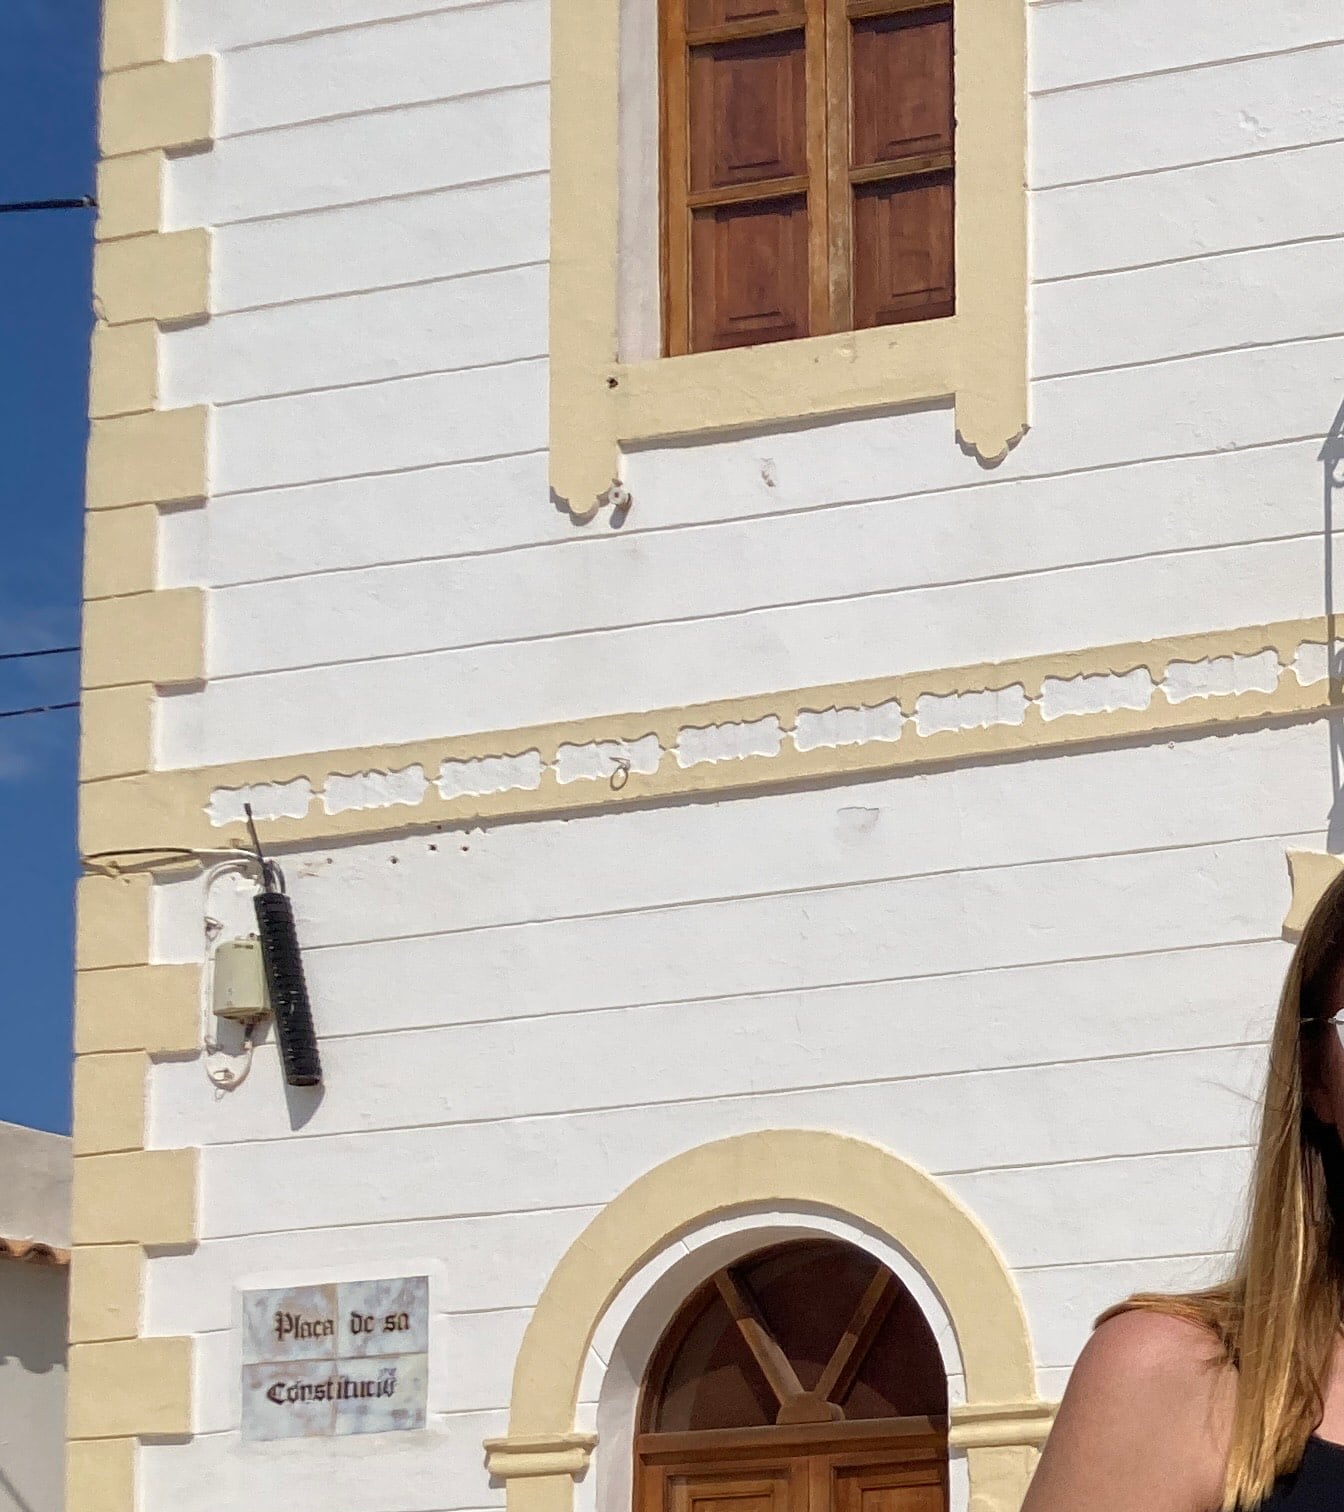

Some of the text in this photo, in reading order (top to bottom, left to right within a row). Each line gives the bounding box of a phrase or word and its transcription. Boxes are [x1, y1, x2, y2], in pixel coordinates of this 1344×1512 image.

[274, 1311, 410, 1342] Plaça de sa
